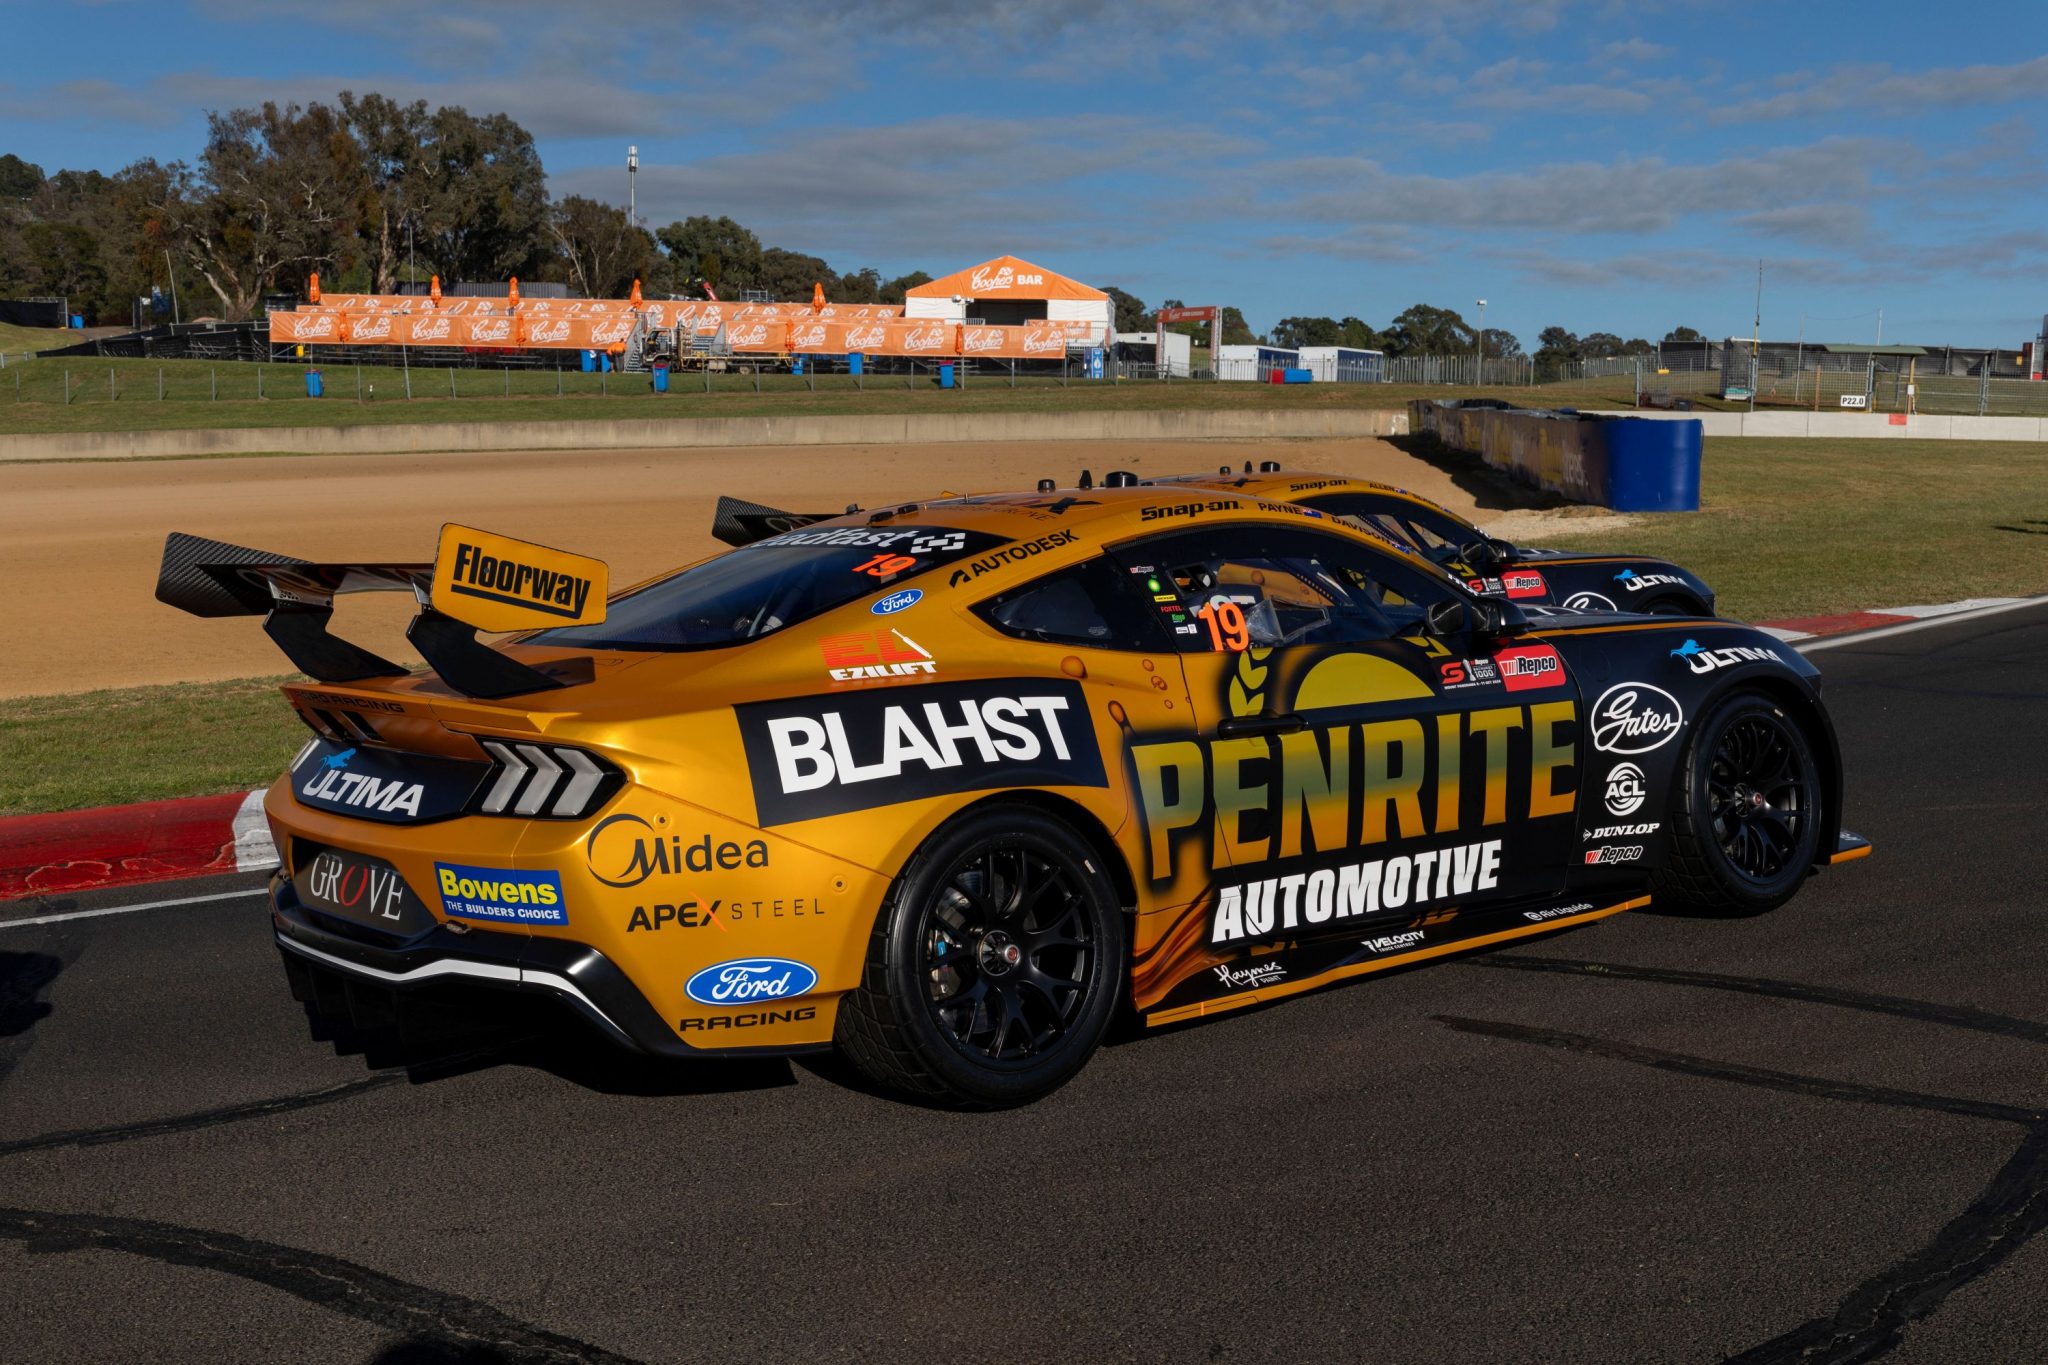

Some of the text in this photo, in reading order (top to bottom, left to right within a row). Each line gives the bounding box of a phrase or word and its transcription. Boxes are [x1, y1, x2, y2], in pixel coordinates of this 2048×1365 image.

[971, 266, 1043, 293] Coopers BAR
[1842, 397, 1864, 405] P22.0
[1290, 478, 1348, 492] Snap-on
[1141, 500, 1240, 522] Snap-on
[1258, 502, 1303, 515] PAYNE
[1331, 515, 1391, 545] DAVISON
[971, 529, 1080, 577] AUTODESK
[852, 553, 917, 577] 19
[452, 542, 591, 612] Floorway
[1514, 575, 1541, 589] Repco
[1625, 574, 1689, 591] ULTIMA
[1160, 605, 1182, 613] FOXTEL
[1198, 602, 1249, 651] 19
[829, 661, 936, 681] EZILIFT
[1514, 656, 1557, 676] Repco
[1690, 647, 1784, 674] ULTIMA
[1475, 670, 1494, 679] 1000
[333, 695, 405, 713] RACING
[1594, 691, 1678, 750] Gates
[767, 696, 1071, 794] BLAHST
[303, 769, 424, 816] ULTIMA
[1131, 700, 1576, 880] PENRITE
[1604, 780, 1645, 799] ACL
[1592, 823, 1660, 839] DUNLOP
[1598, 846, 1643, 864] Repco
[310, 852, 404, 920] GROVE
[439, 868, 558, 905] Bowens
[1211, 839, 1502, 943] AUTOMOTIVE
[445, 900, 560, 919] THE BUILDERS CHOICE
[627, 892, 825, 932] APEX STEEL
[1540, 903, 1594, 918] Air Liquide
[1373, 930, 1425, 948] VELOCITY
[1213, 961, 1287, 987] Haymes
[1261, 974, 1281, 983] PAINT
[679, 1007, 816, 1031] RACING
